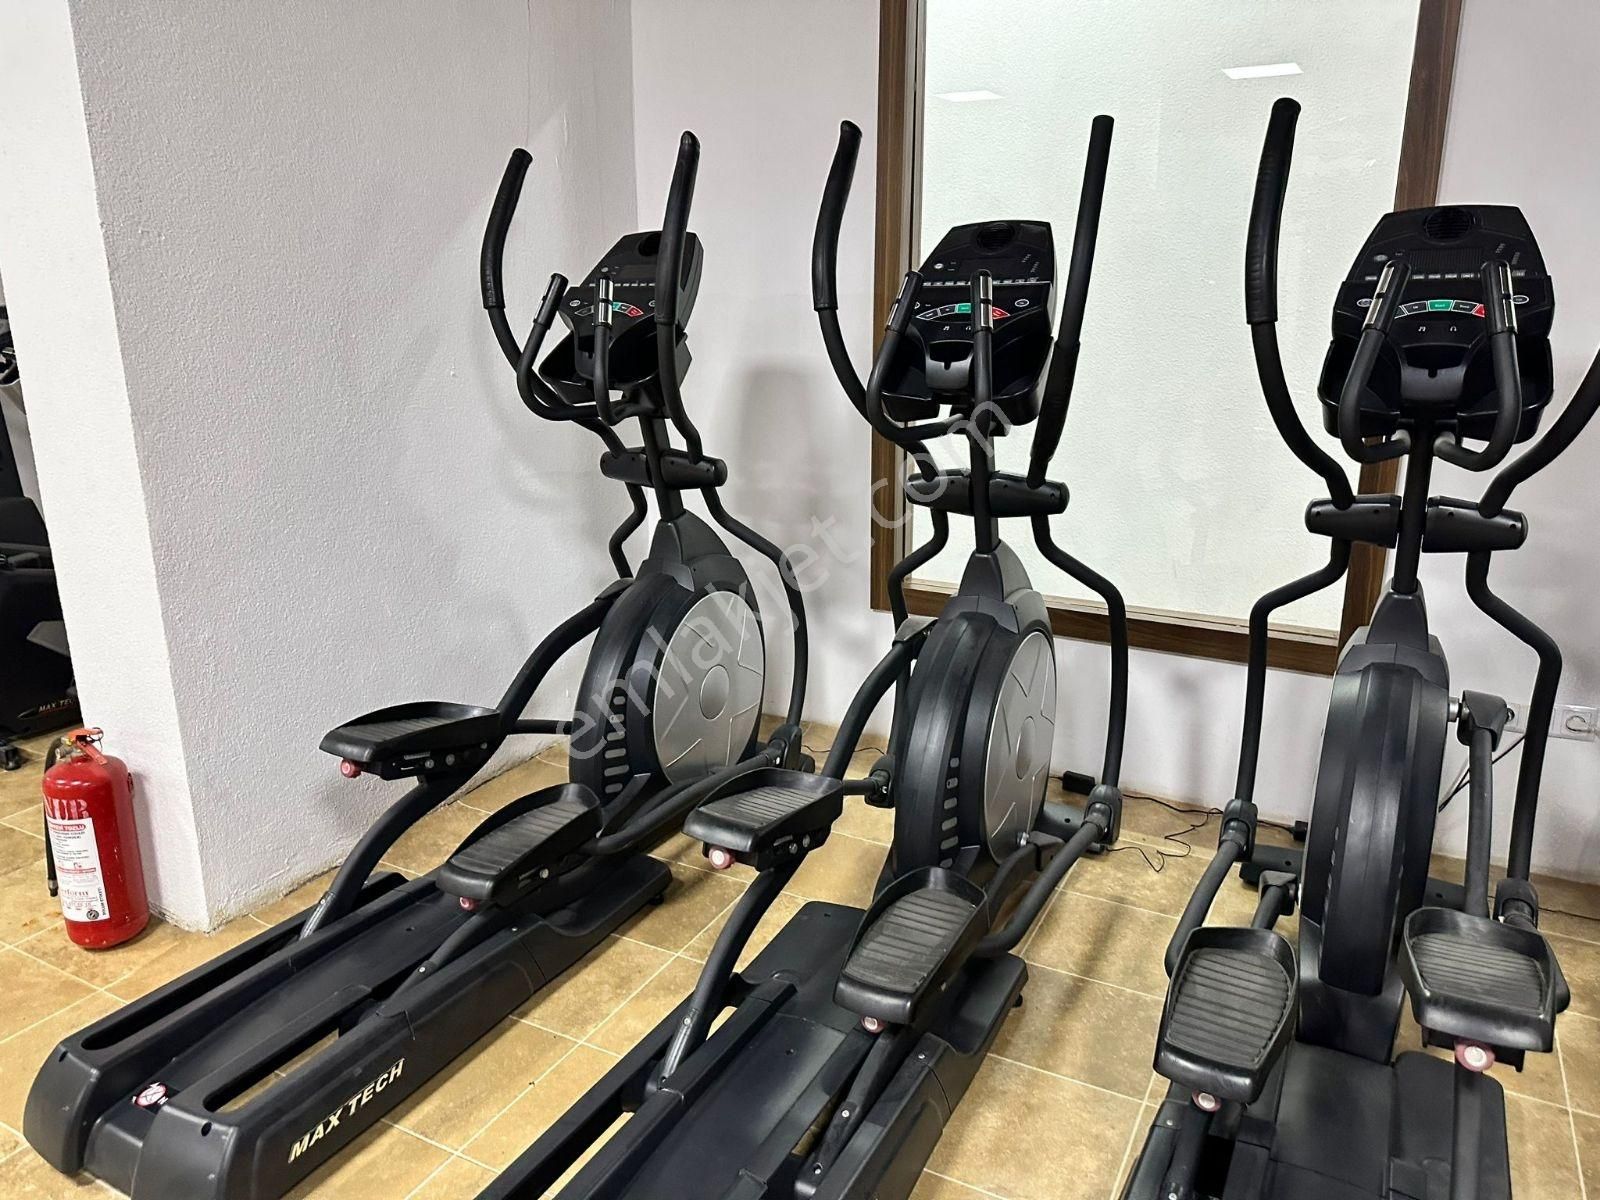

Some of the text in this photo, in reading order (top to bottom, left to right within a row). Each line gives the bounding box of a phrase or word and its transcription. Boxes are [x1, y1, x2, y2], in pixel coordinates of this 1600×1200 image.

[39, 703, 57, 713] MAX
[288, 1057, 406, 1164] MAX TECH
